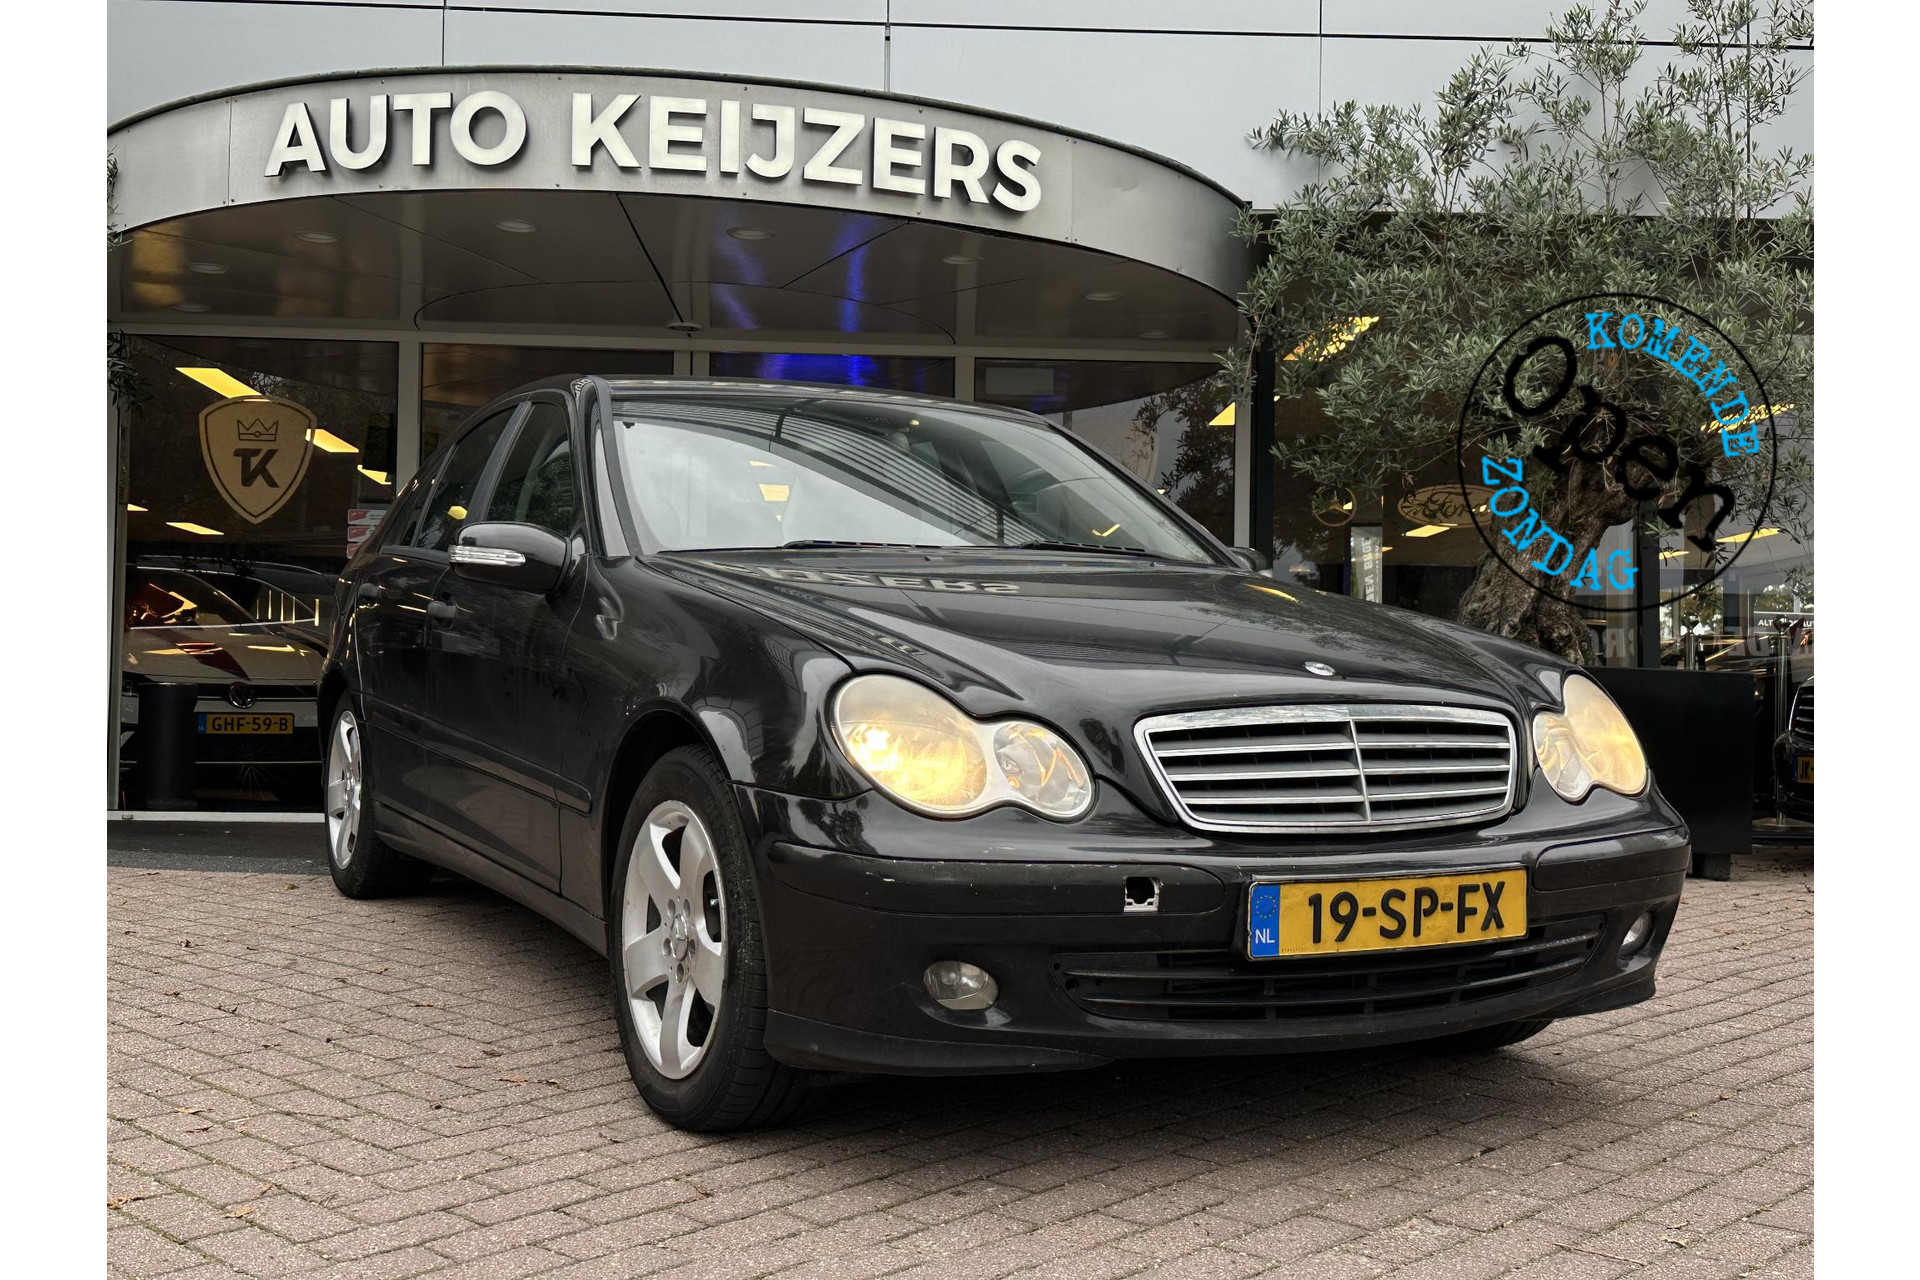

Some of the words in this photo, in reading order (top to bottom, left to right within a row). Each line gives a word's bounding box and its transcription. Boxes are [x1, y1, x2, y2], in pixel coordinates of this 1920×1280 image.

[264, 90, 528, 177] AUTO
[571, 92, 1043, 213] KEIJZERS
[211, 716, 288, 732] GHF-59-B
[1255, 928, 1275, 945] NL
[1308, 880, 1506, 944] 19-SP-FX
